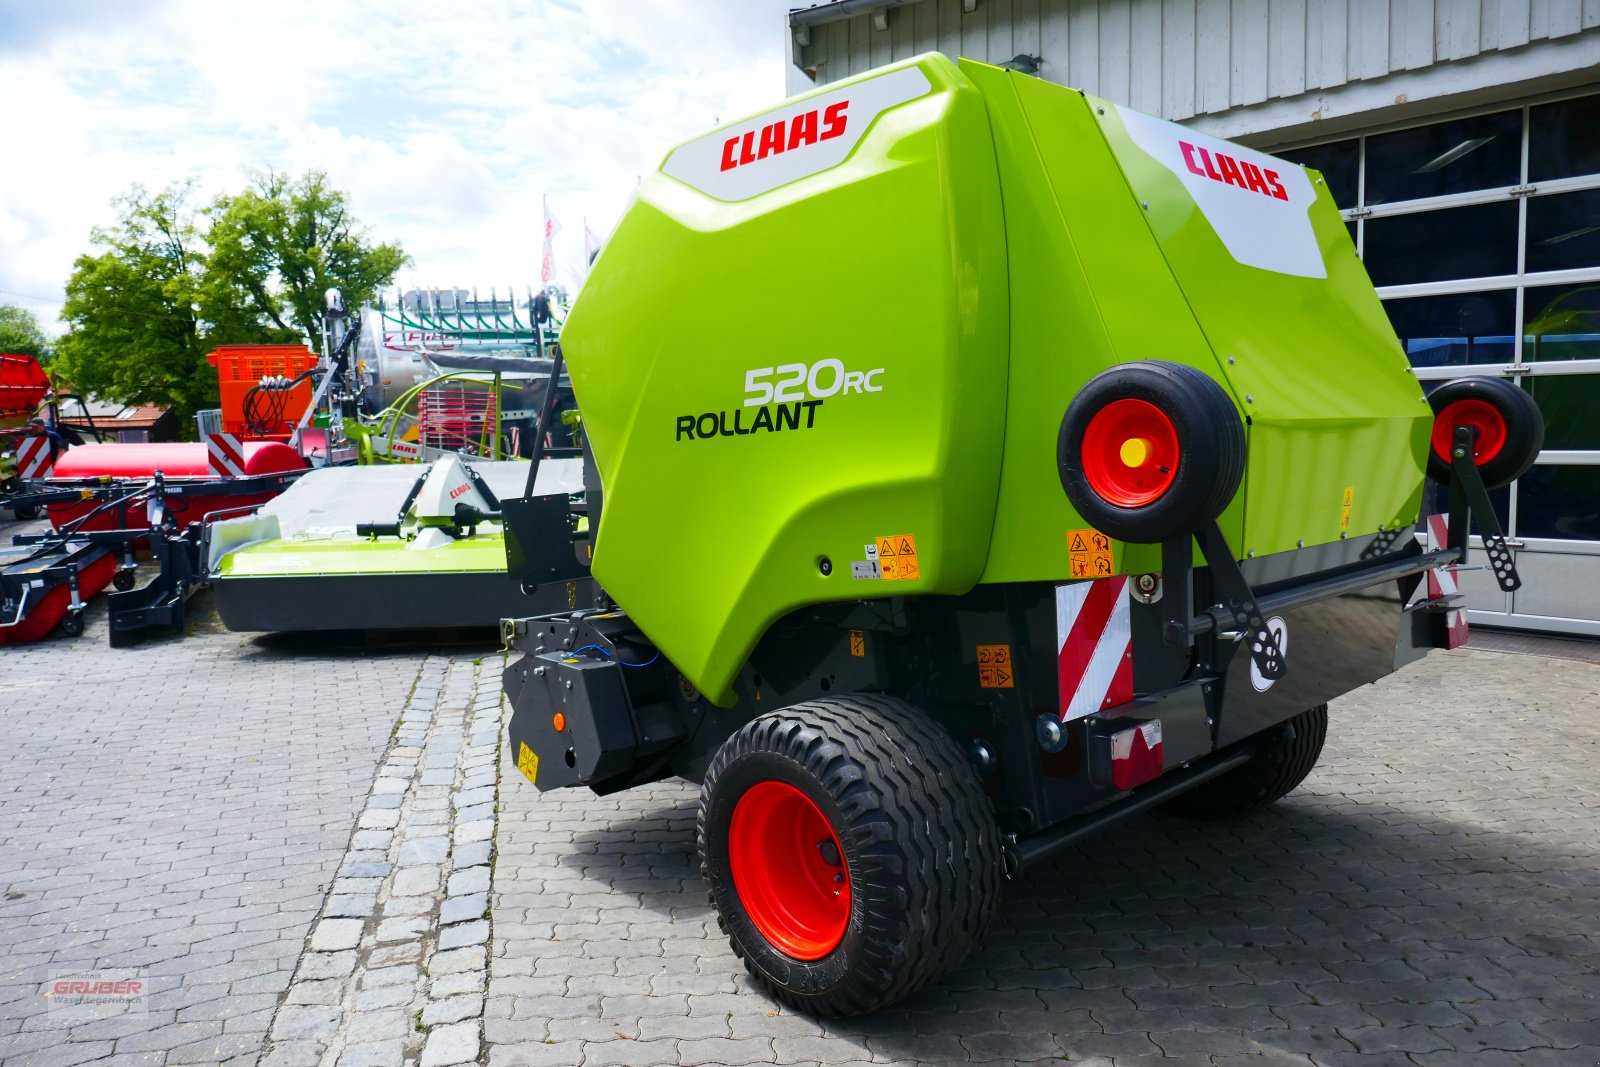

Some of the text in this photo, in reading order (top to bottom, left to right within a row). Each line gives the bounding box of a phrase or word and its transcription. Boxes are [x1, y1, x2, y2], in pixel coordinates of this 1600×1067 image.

[720, 100, 850, 172] CLAAS
[1178, 140, 1289, 202] CLAAS
[676, 400, 824, 442] ROLLANT
[450, 483, 470, 499] CLAAS
